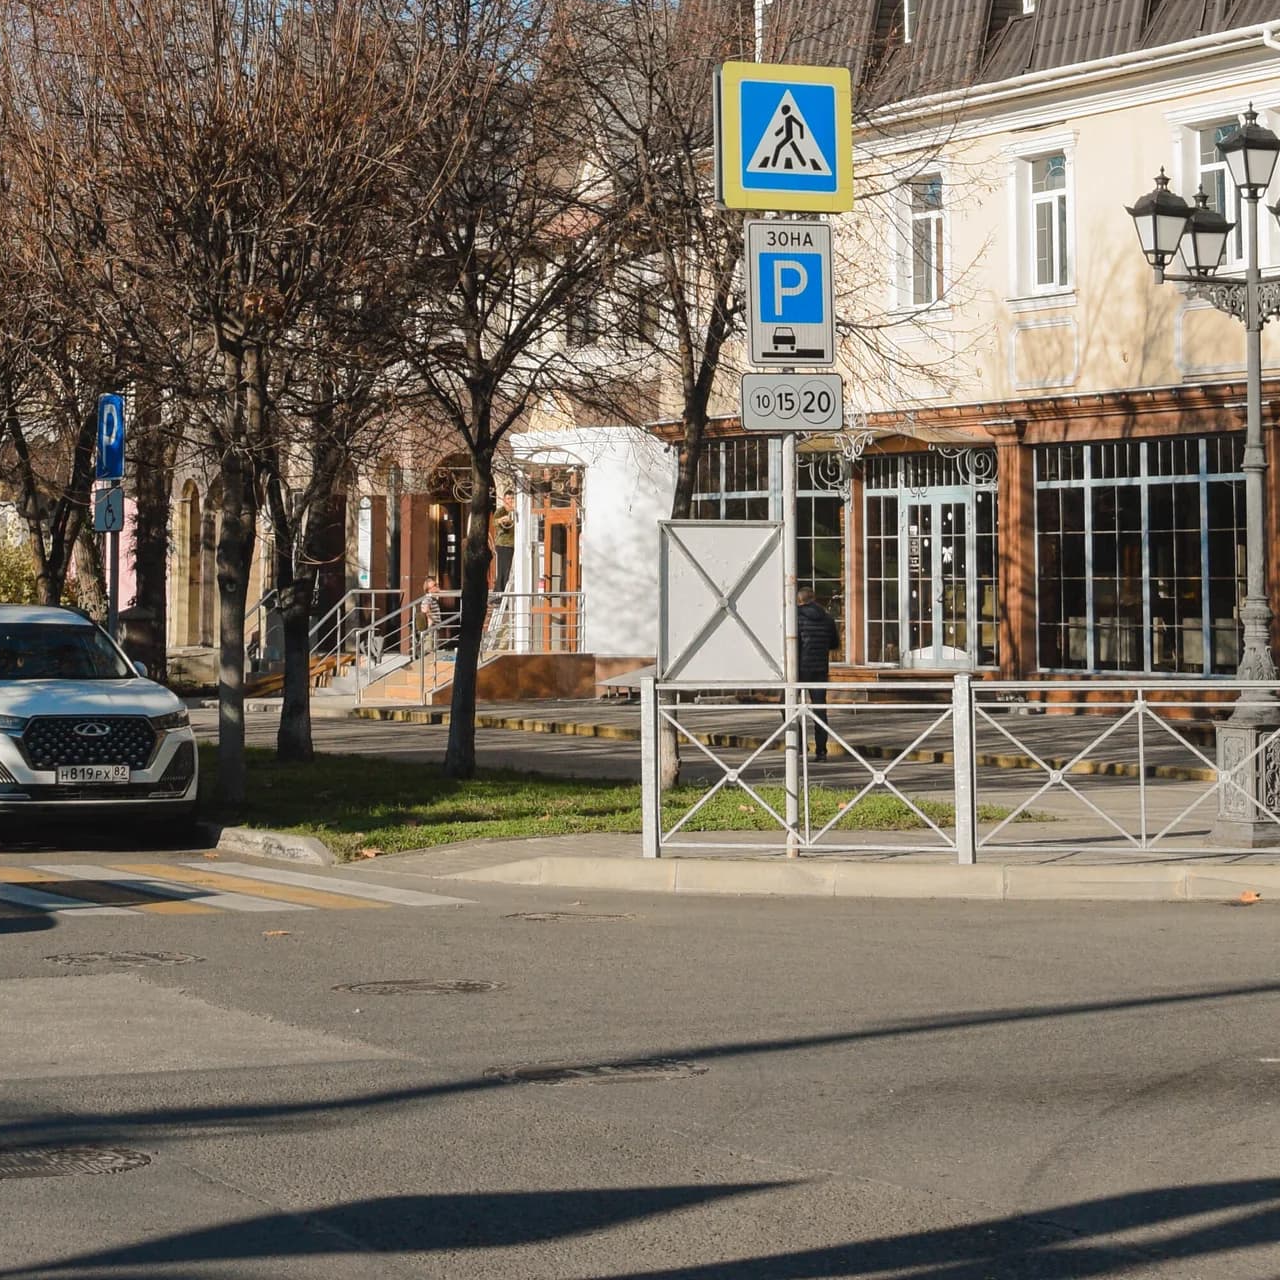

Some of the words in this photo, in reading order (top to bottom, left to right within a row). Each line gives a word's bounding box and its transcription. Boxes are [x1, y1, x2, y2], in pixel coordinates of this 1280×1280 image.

[767, 231, 813, 247] ЗОНА
[773, 260, 808, 316] P
[756, 394, 770, 409] 10
[777, 392, 794, 411] 15
[802, 391, 831, 413] 20
[102, 403, 118, 470] P
